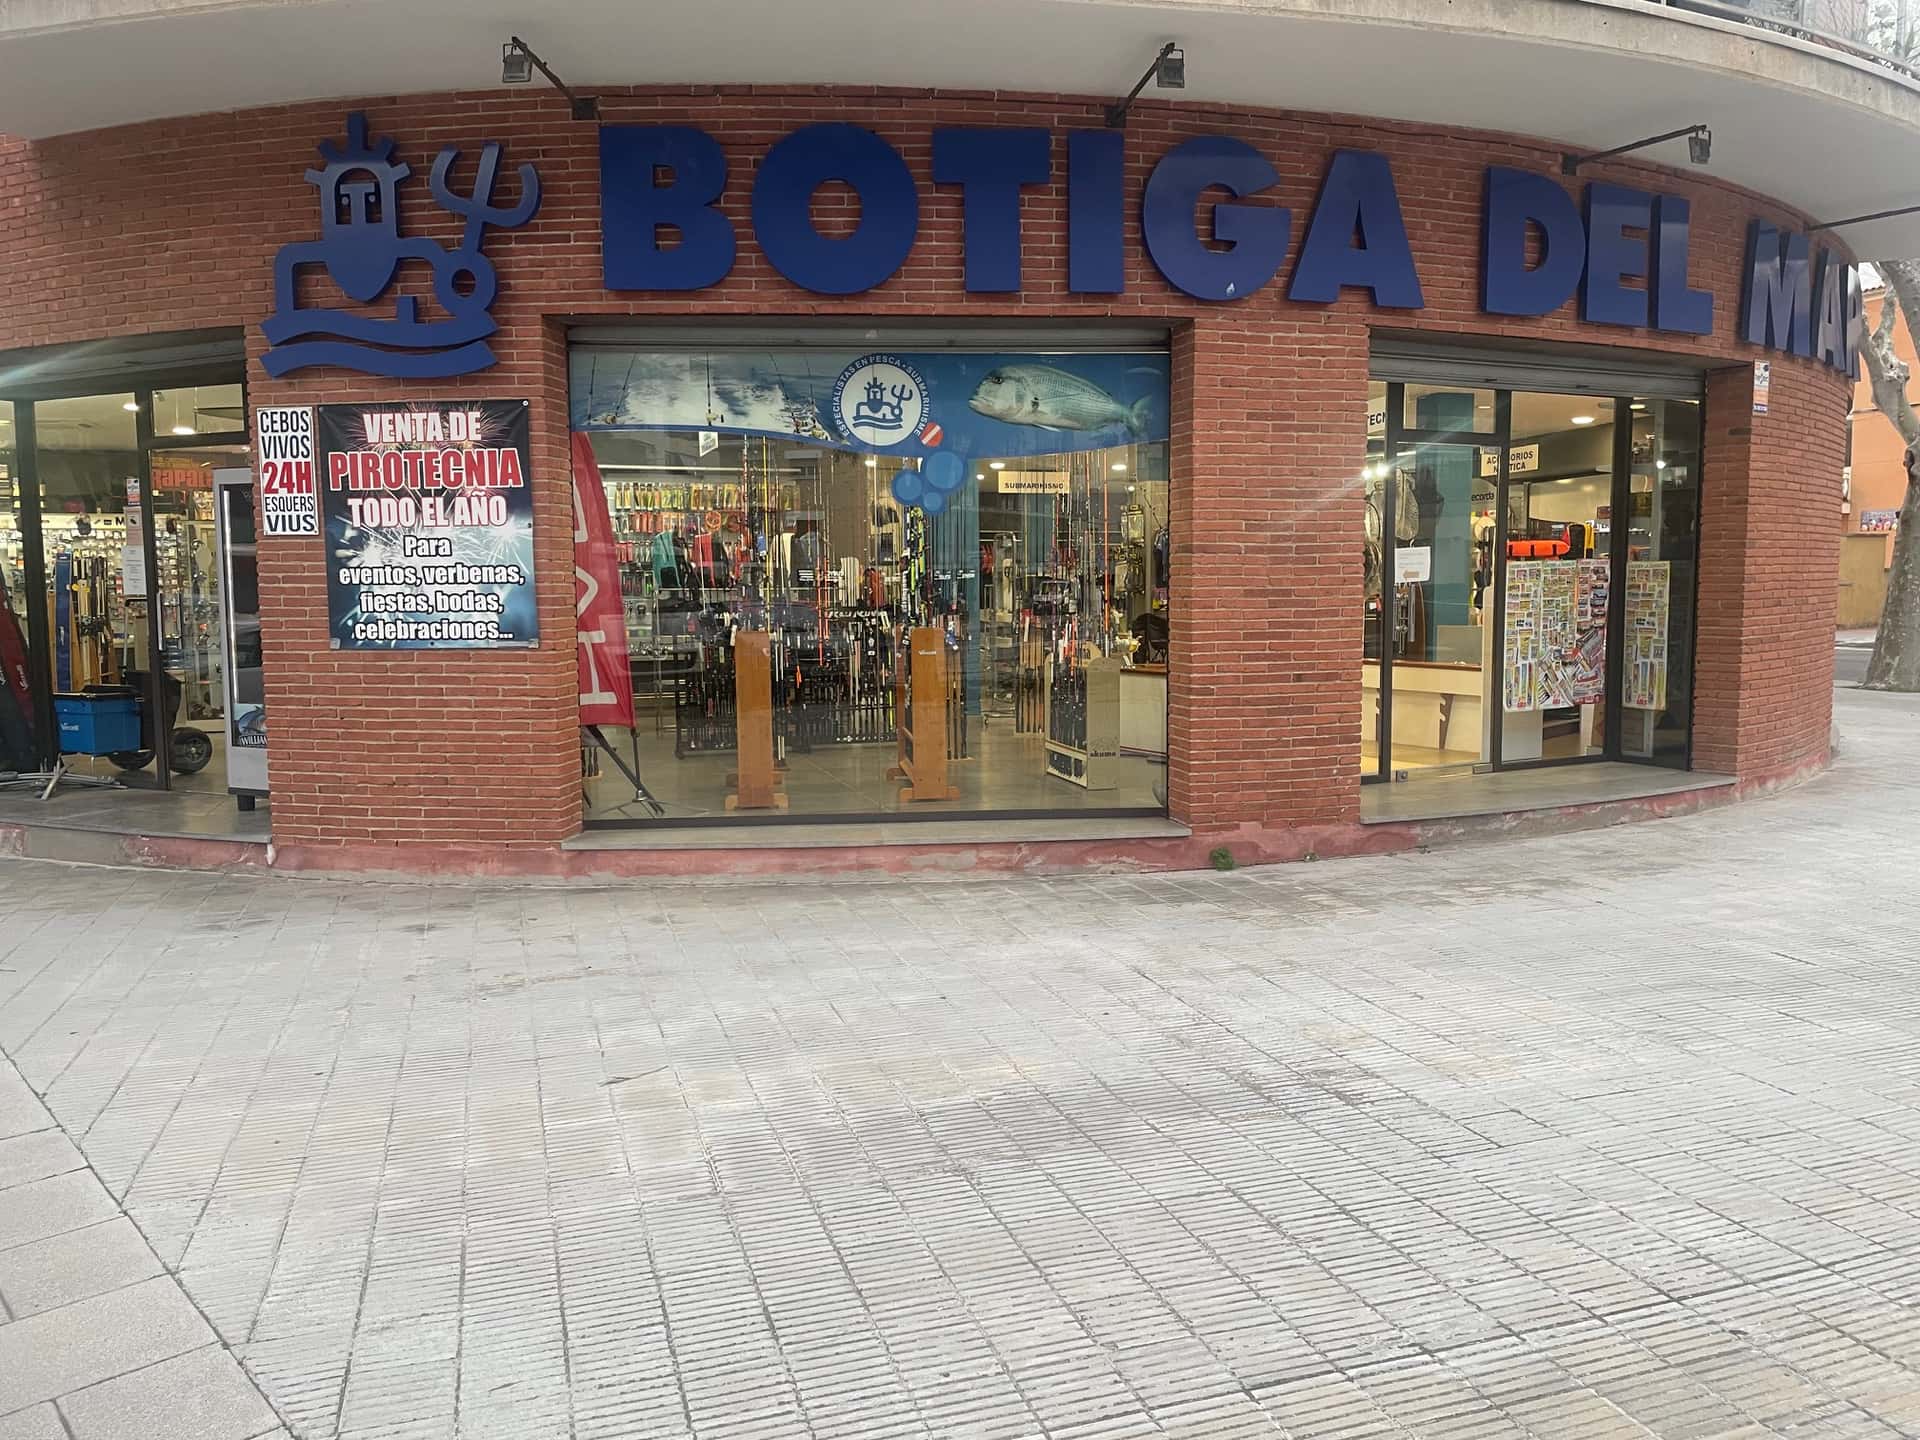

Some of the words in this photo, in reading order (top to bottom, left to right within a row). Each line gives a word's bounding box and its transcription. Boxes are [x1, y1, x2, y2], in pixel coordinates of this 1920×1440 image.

[600, 121, 1424, 309] BOTIGA
[1484, 165, 1712, 335] DEL
[833, 366, 856, 437] ESPECIALISTAS
[855, 358, 868, 369] EN
[869, 355, 901, 366] PESCA
[260, 411, 309, 433] CEBOS
[363, 412, 445, 443] VENTA
[449, 411, 482, 441] DE
[261, 435, 310, 460] VIVOS
[262, 461, 312, 494] 24H
[329, 449, 524, 490] PIROTECNIA
[265, 495, 314, 513] ESQUERS
[347, 497, 416, 527] TODO
[422, 497, 448, 526] EL
[453, 491, 508, 526] AÑO
[266, 514, 315, 532] VIUS
[404, 536, 451, 557] Para
[339, 566, 421, 585] eventos,
[424, 564, 525, 584] verbenas,
[360, 593, 434, 613] fiestas,
[436, 591, 504, 612] bodas,
